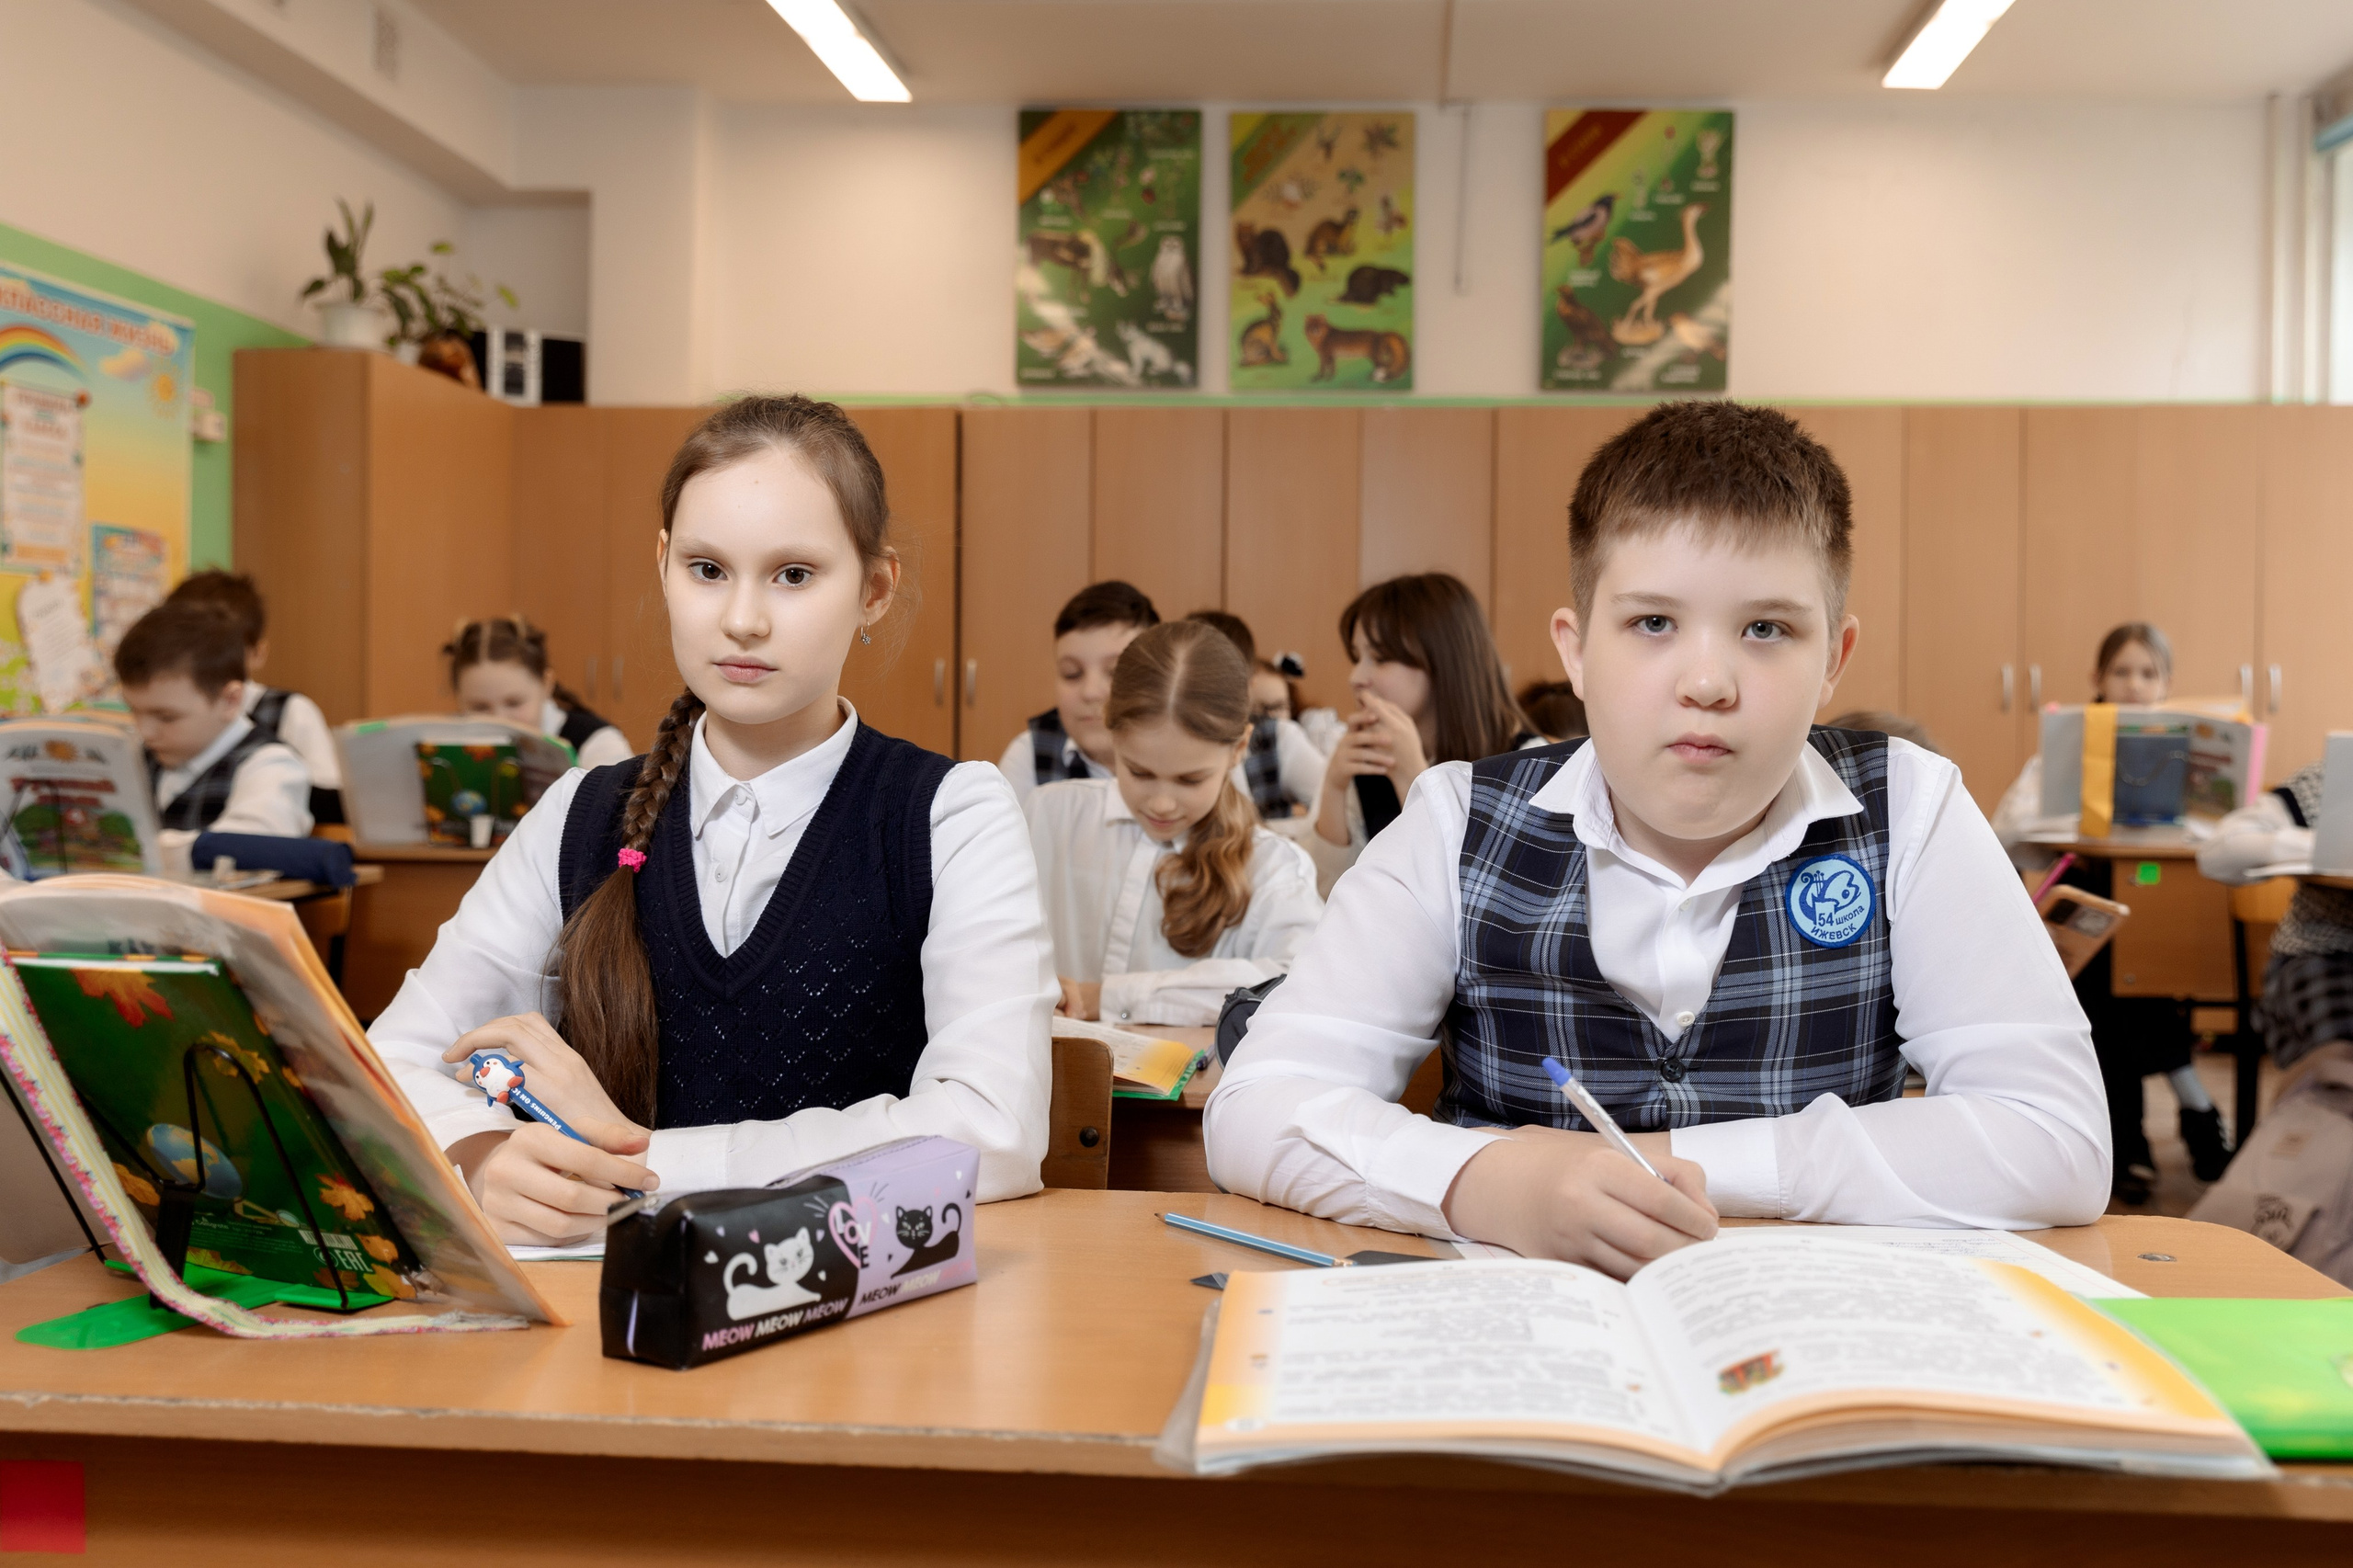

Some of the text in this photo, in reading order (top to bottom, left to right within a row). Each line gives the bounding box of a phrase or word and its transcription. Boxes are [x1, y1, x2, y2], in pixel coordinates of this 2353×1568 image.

[1811, 923, 1858, 940] ИЖЕВСК
[1818, 904, 1865, 927] 54 школа
[511, 1087, 563, 1131] PENGUINS ON IC
[859, 1283, 902, 1306] MEOW
[900, 1269, 941, 1294] MEOW
[702, 1298, 849, 1351] MEOW MEOW MEOW
